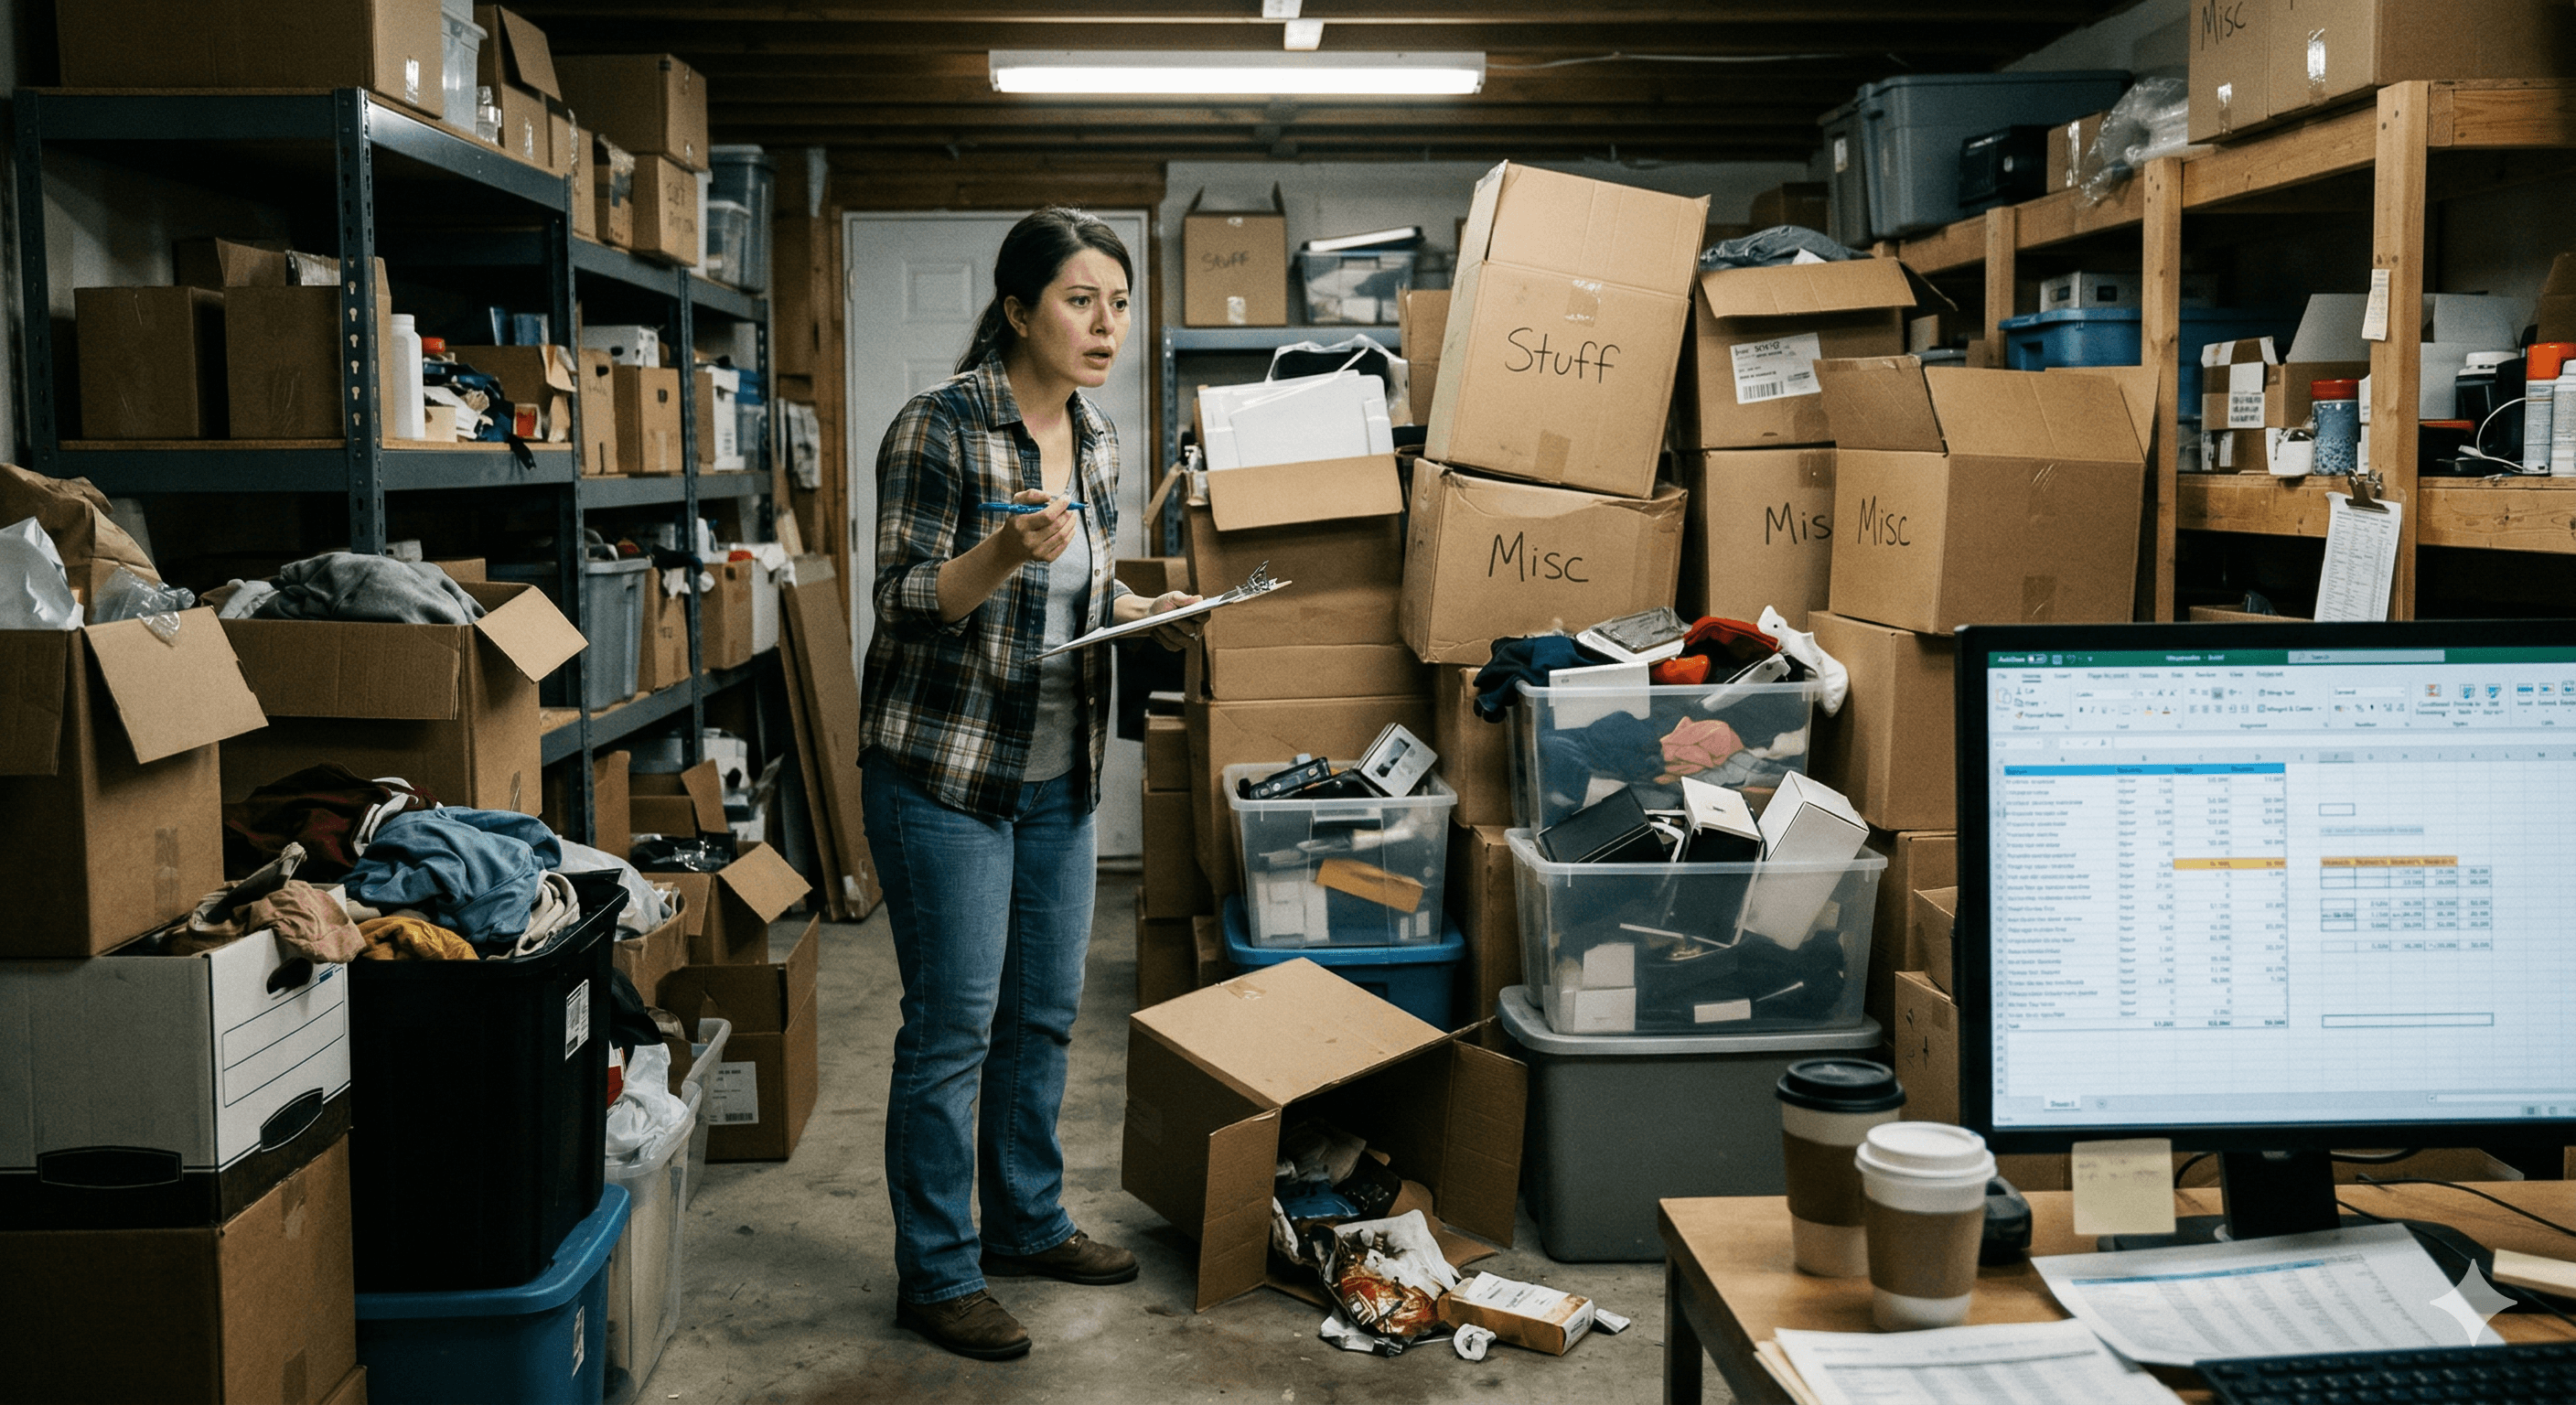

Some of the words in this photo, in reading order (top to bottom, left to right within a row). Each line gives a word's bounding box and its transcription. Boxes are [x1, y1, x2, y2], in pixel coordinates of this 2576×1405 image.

[2201, 0, 2247, 51] Misc
[1505, 327, 1621, 384] Stuff
[1766, 501, 1832, 545] Mis
[1858, 495, 1911, 546] Misc
[1487, 531, 1590, 583] Misc
